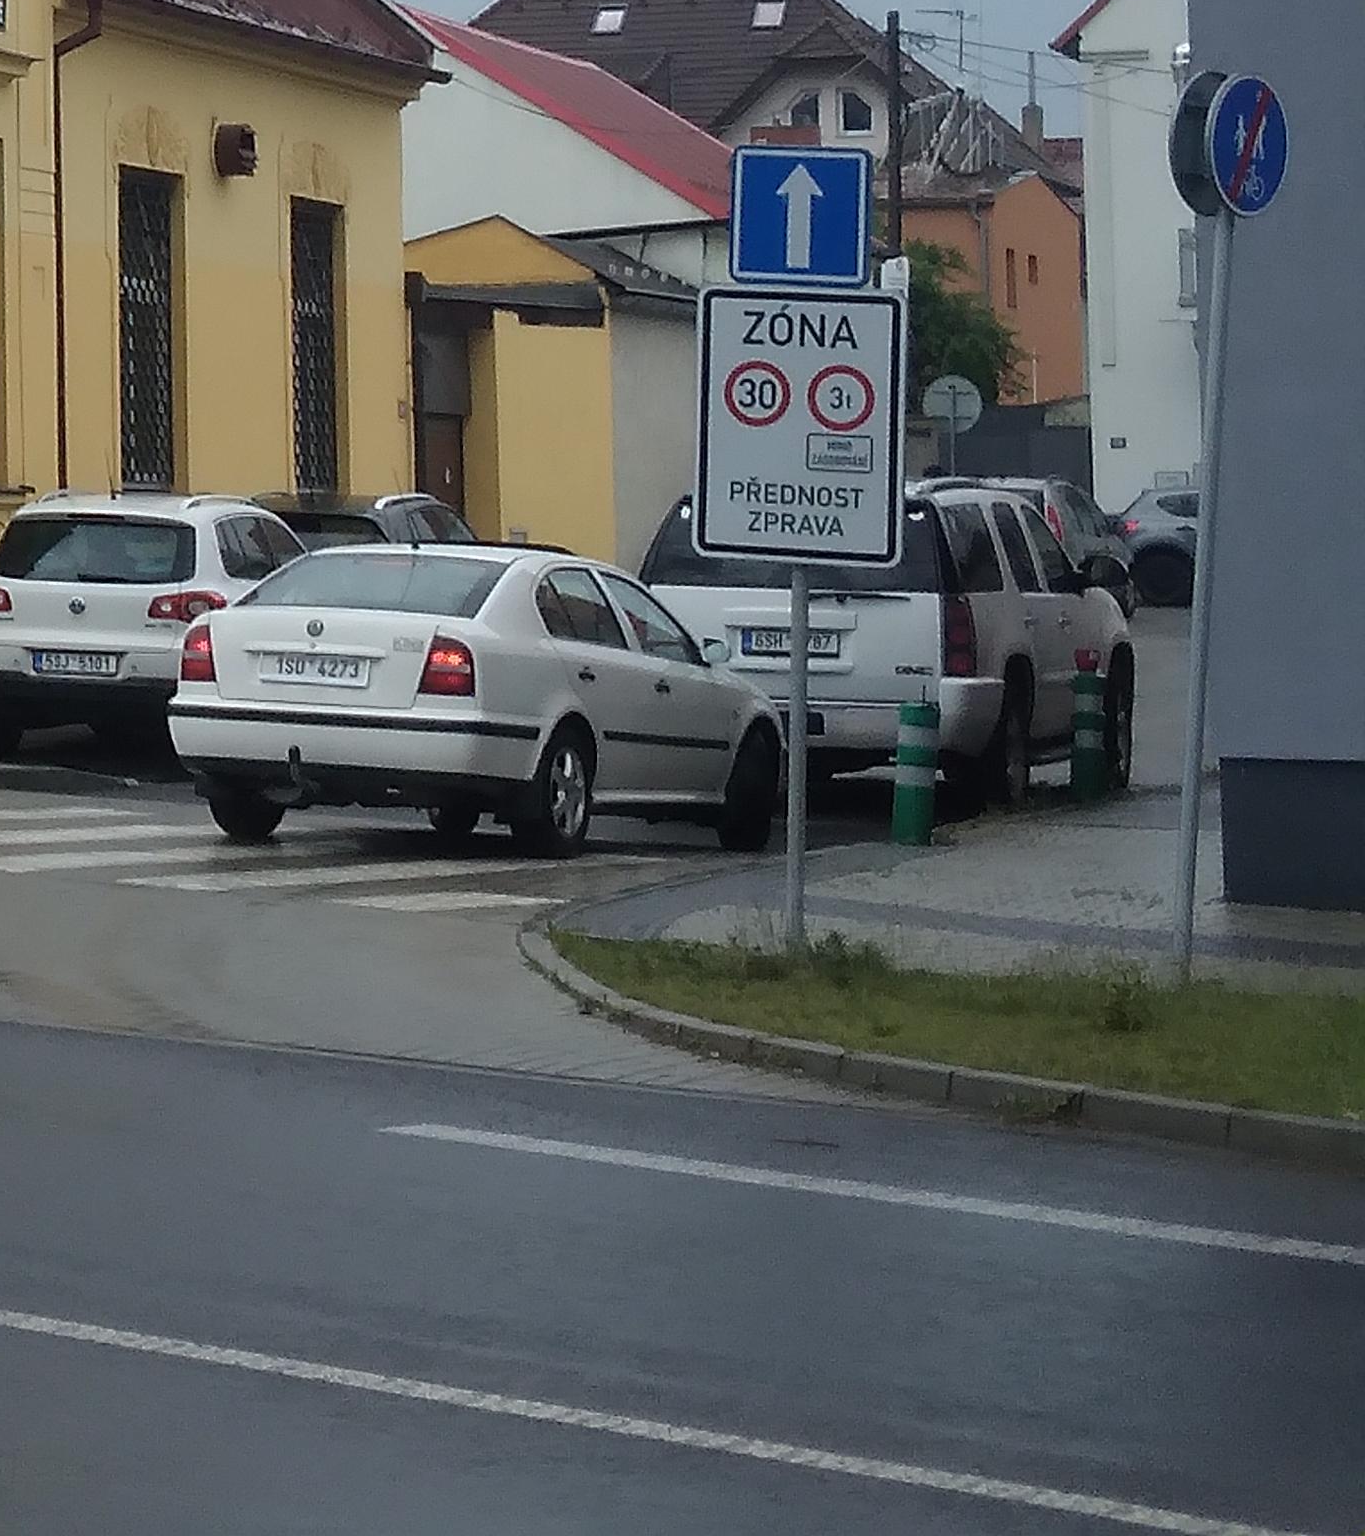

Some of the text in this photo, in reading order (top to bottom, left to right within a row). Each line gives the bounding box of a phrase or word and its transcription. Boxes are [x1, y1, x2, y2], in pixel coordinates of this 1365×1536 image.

[742, 304, 858, 350] ZÓNA
[738, 378, 777, 409] 30
[829, 386, 851, 410] 3t
[729, 476, 864, 509] PŘEDNOST
[748, 510, 844, 537] ZPRAVA
[318, 661, 359, 678] 4273
